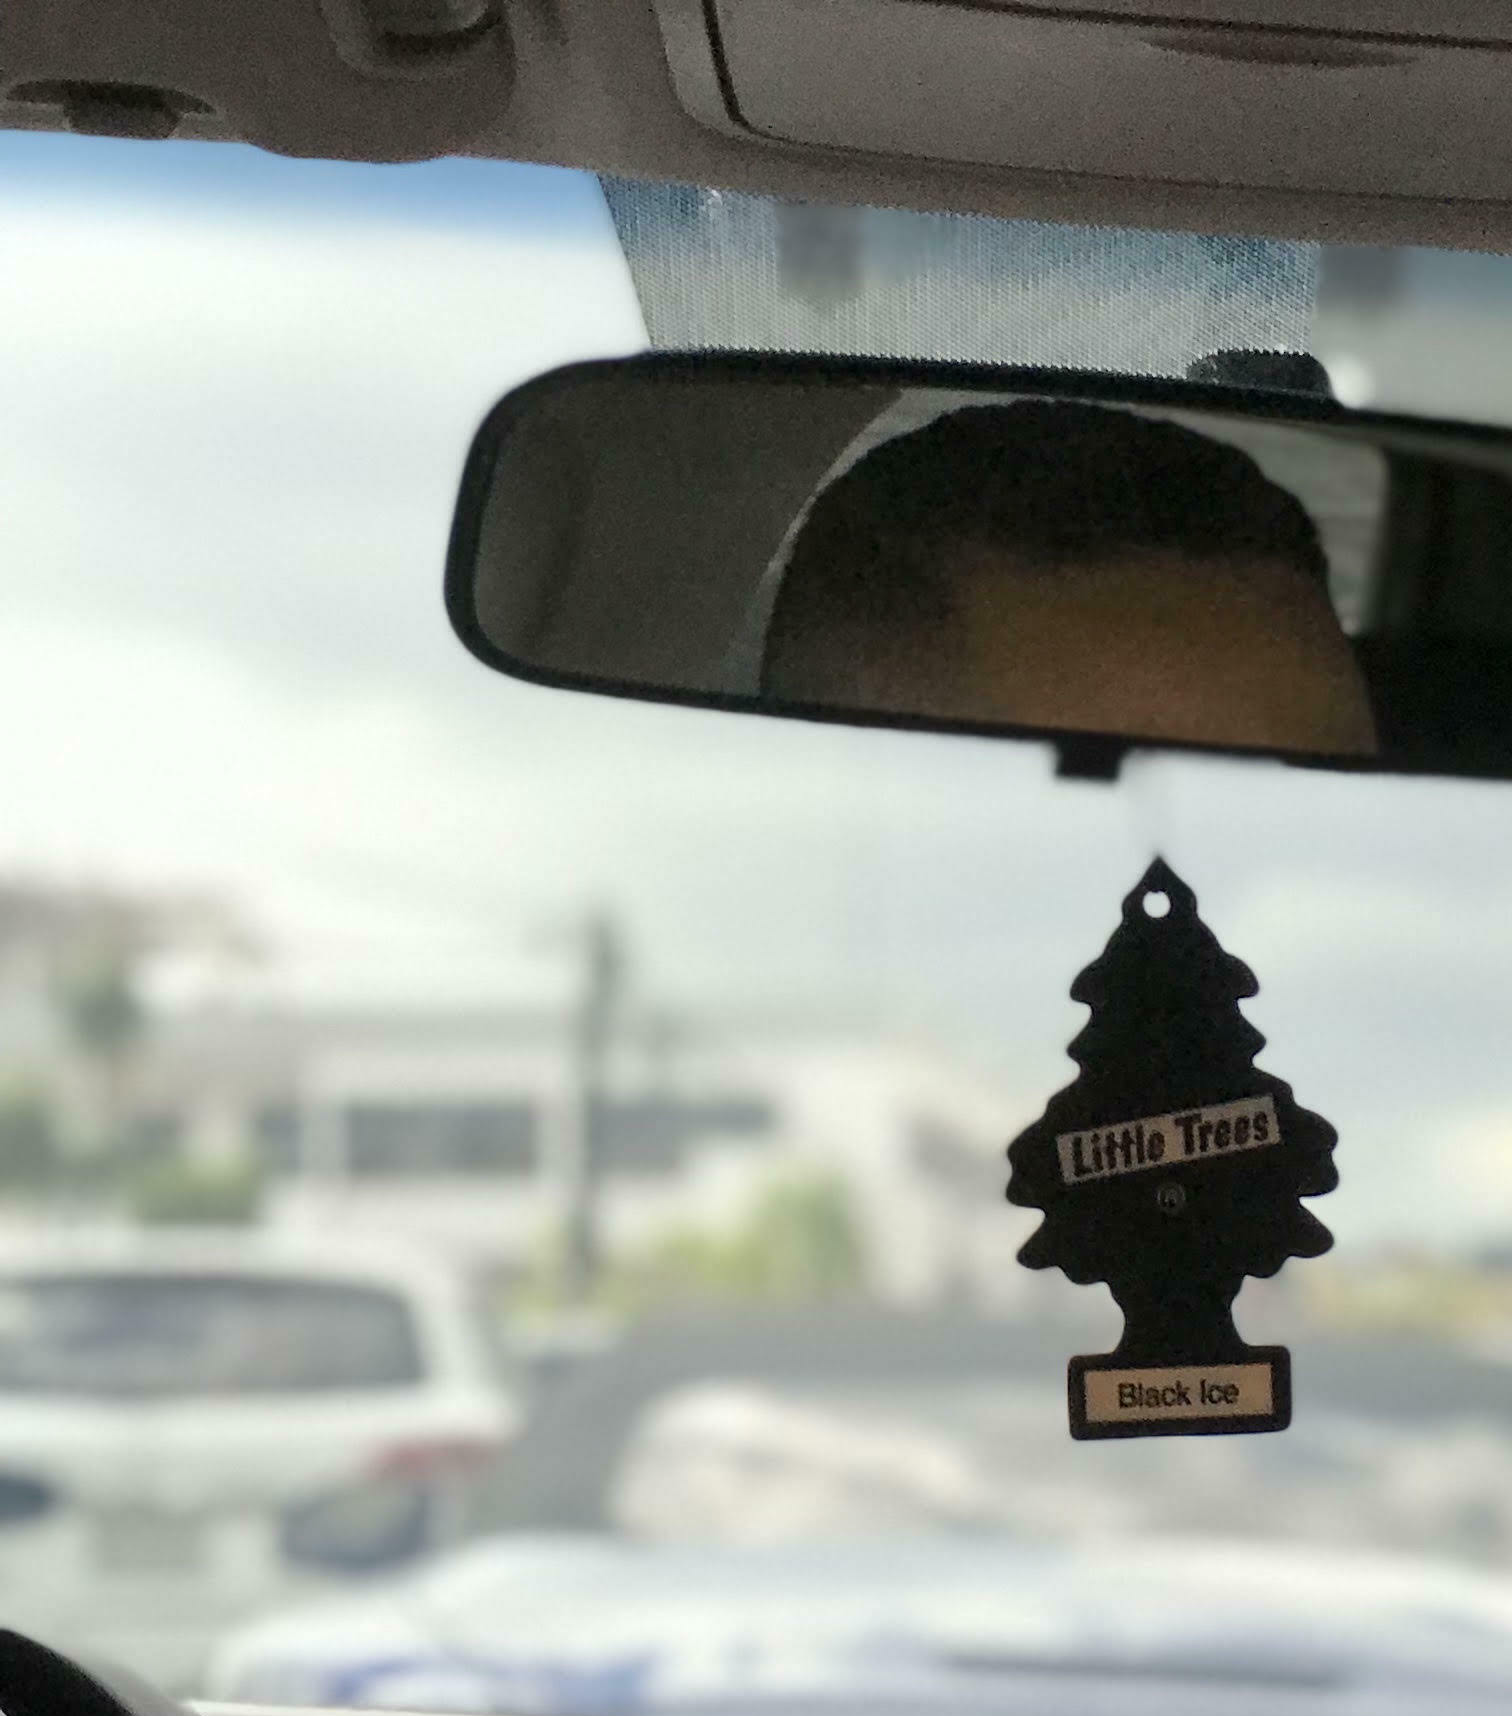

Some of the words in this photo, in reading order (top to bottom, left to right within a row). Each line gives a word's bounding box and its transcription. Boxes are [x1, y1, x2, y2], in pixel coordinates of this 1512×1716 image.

[1070, 1123, 1166, 1177] Little
[1174, 1110, 1269, 1155] Trees
[1118, 1382, 1191, 1409] Black
[1200, 1379, 1240, 1404] Ice
